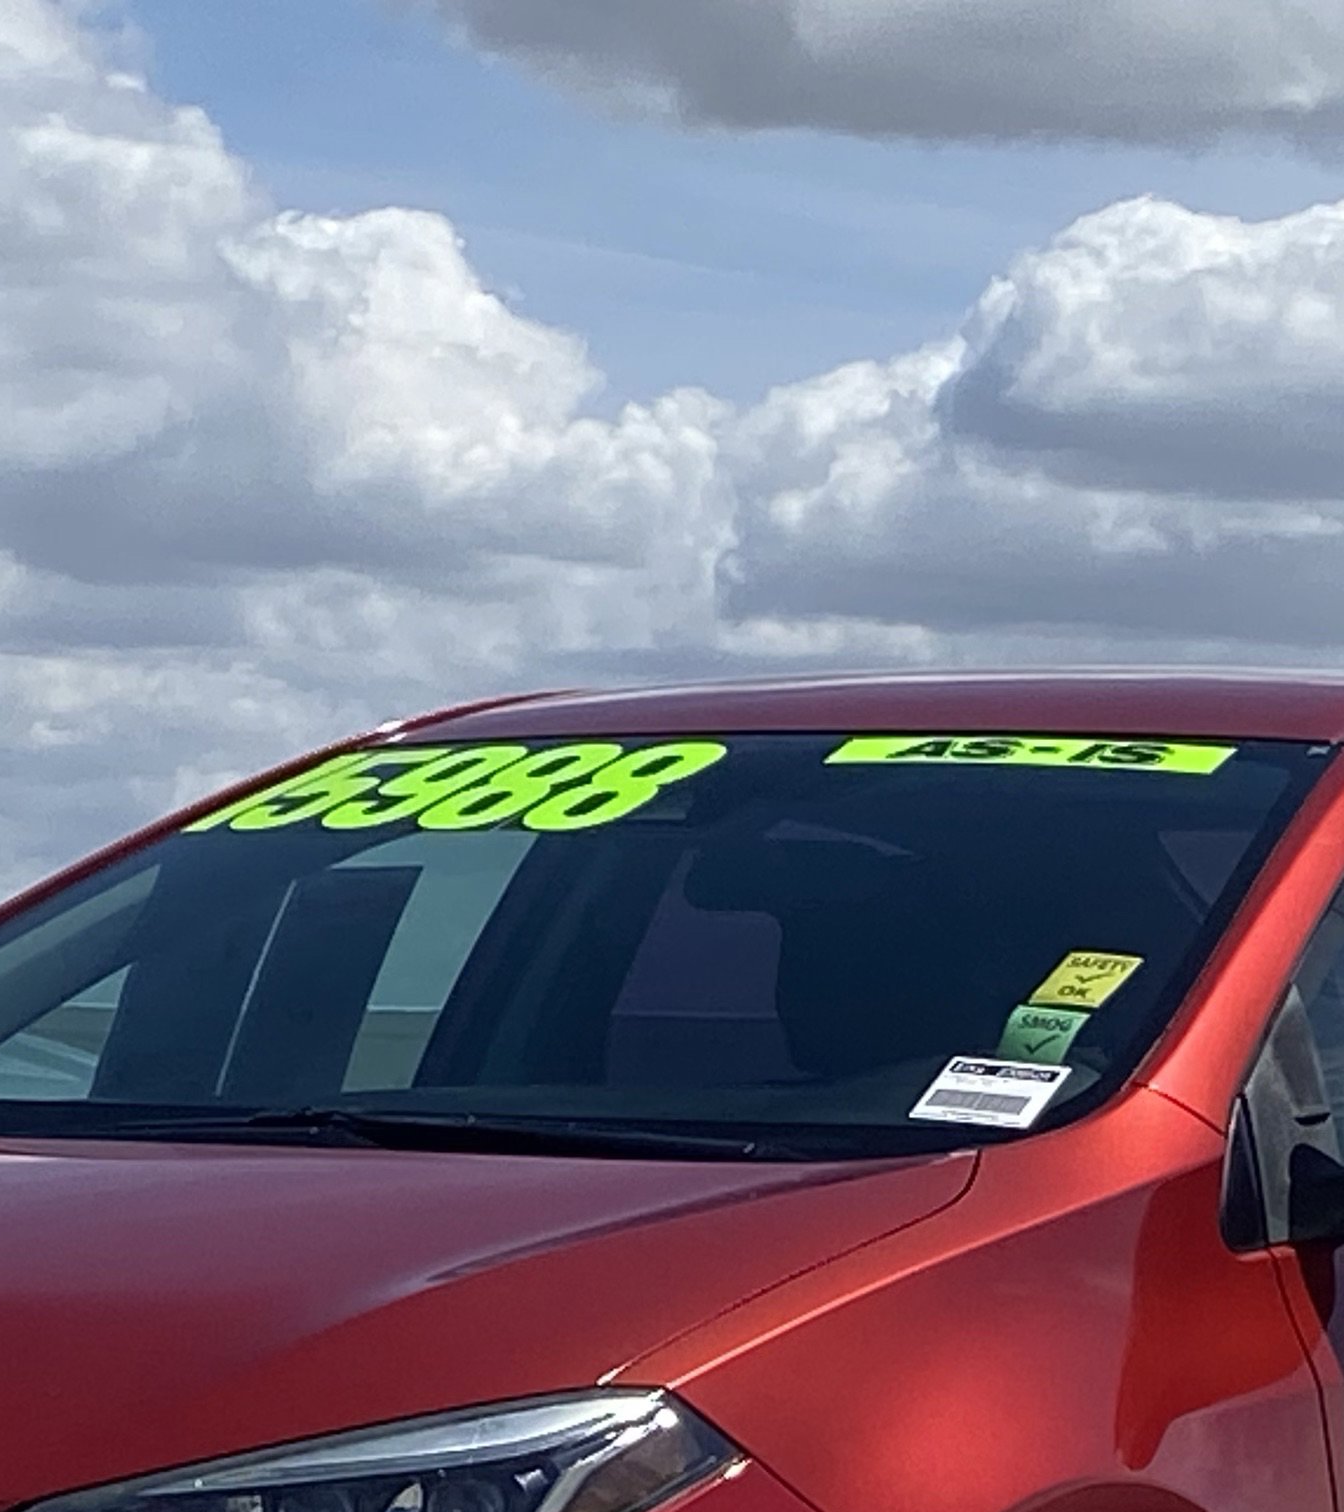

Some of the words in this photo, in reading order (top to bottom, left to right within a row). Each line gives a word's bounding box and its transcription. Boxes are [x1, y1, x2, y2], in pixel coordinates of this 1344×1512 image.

[886, 738, 1173, 765] AS-IS
[181, 742, 727, 830] 15988
[1065, 956, 1130, 973] SAFETY
[1057, 985, 1092, 999] OK
[1018, 1013, 1073, 1033] SMOG
